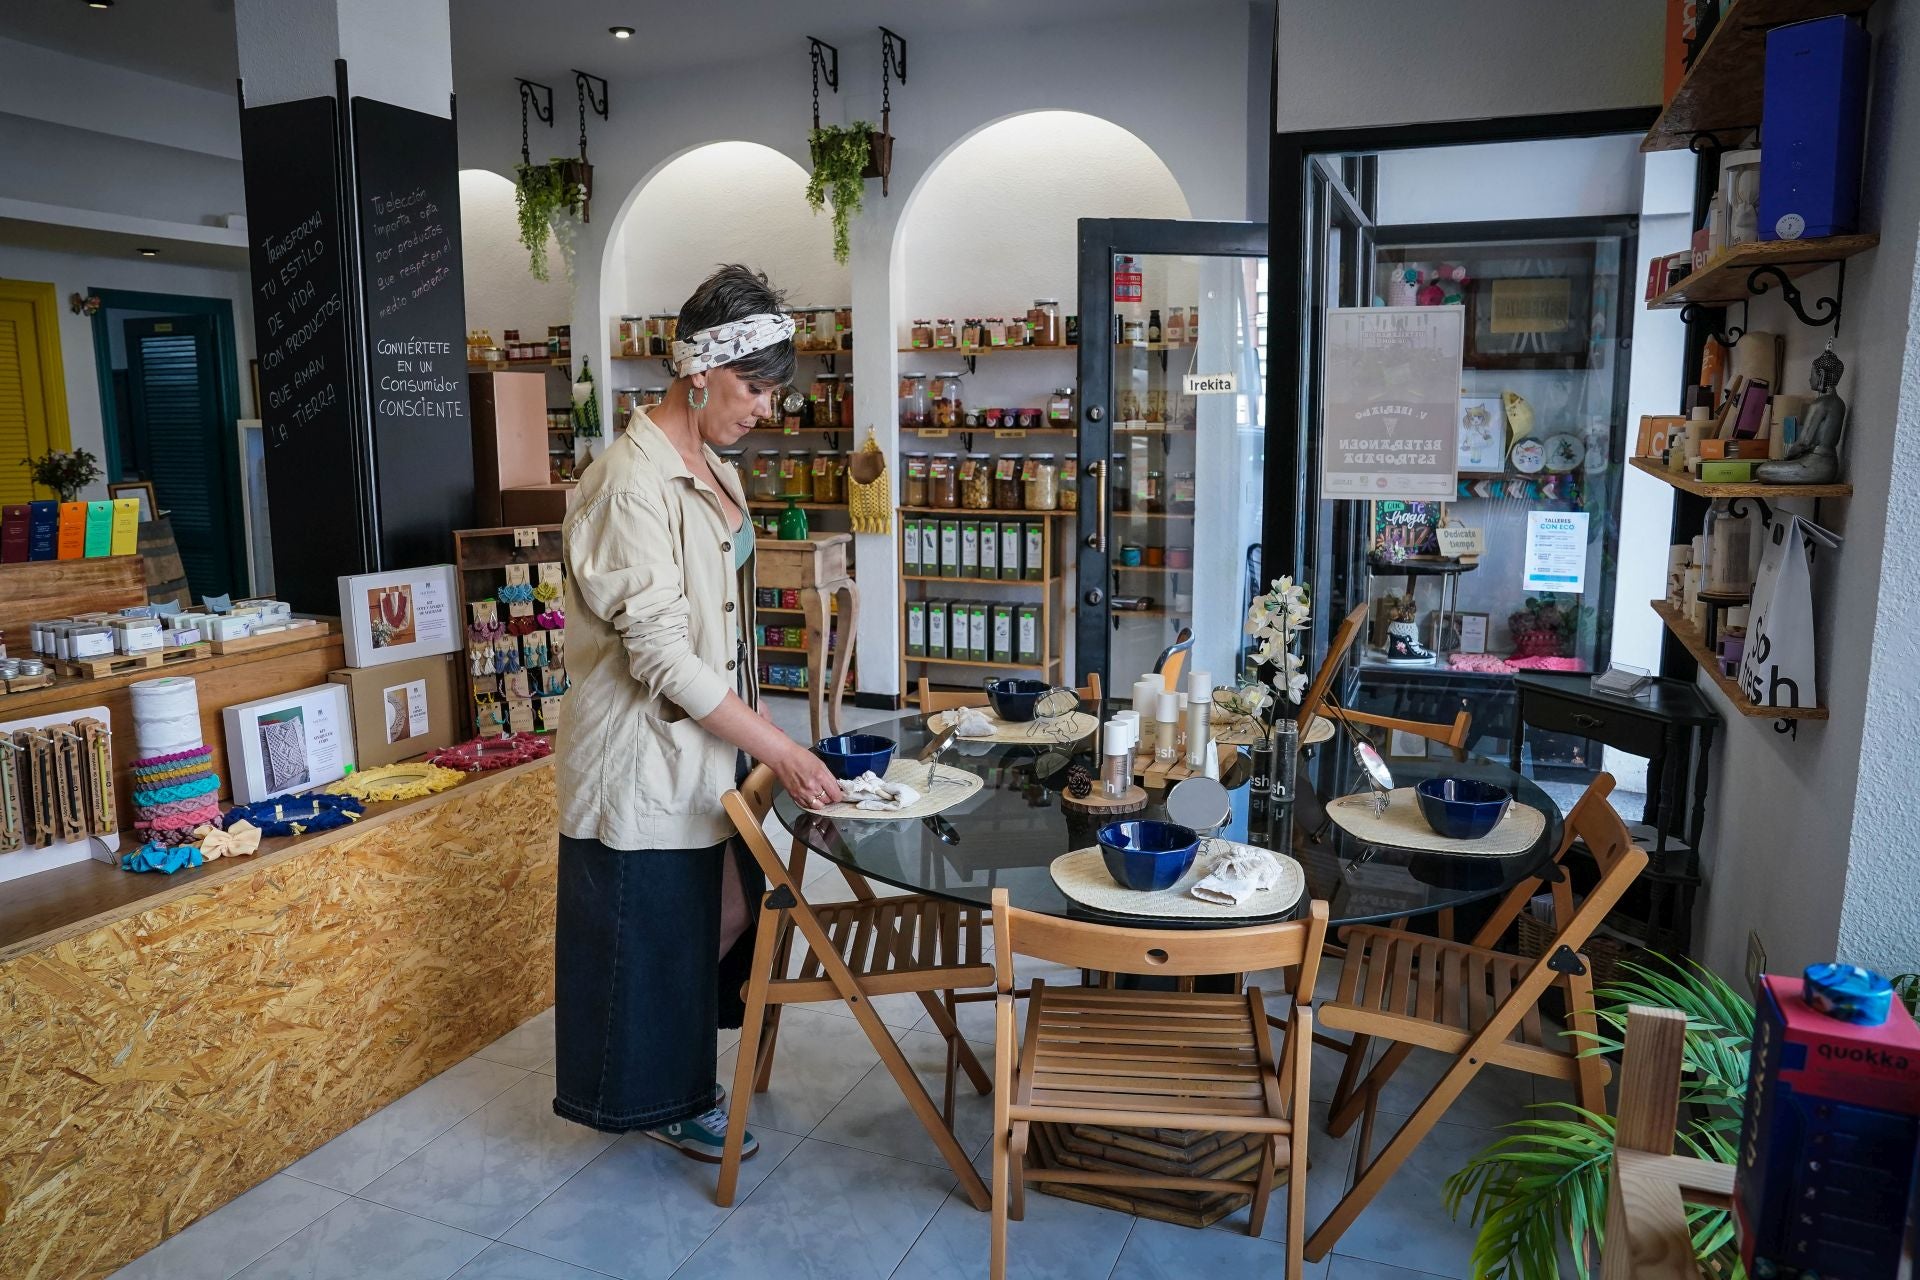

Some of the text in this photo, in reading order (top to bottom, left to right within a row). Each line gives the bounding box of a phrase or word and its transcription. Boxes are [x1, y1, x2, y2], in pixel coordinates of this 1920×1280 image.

[260, 279, 277, 300] TU
[263, 293, 342, 371] CON PRODUCTOS
[267, 311, 285, 337] DE
[397, 360, 433, 373] EN UN
[269, 355, 326, 409] QUE AMAN
[380, 375, 459, 392] Consumidor
[1190, 378, 1231, 391] Irekita
[1386, 511, 1428, 529] haga
[1449, 540, 1475, 550] tiempo
[1752, 615, 1771, 665] So
[1817, 1043, 1909, 1070] quokka
